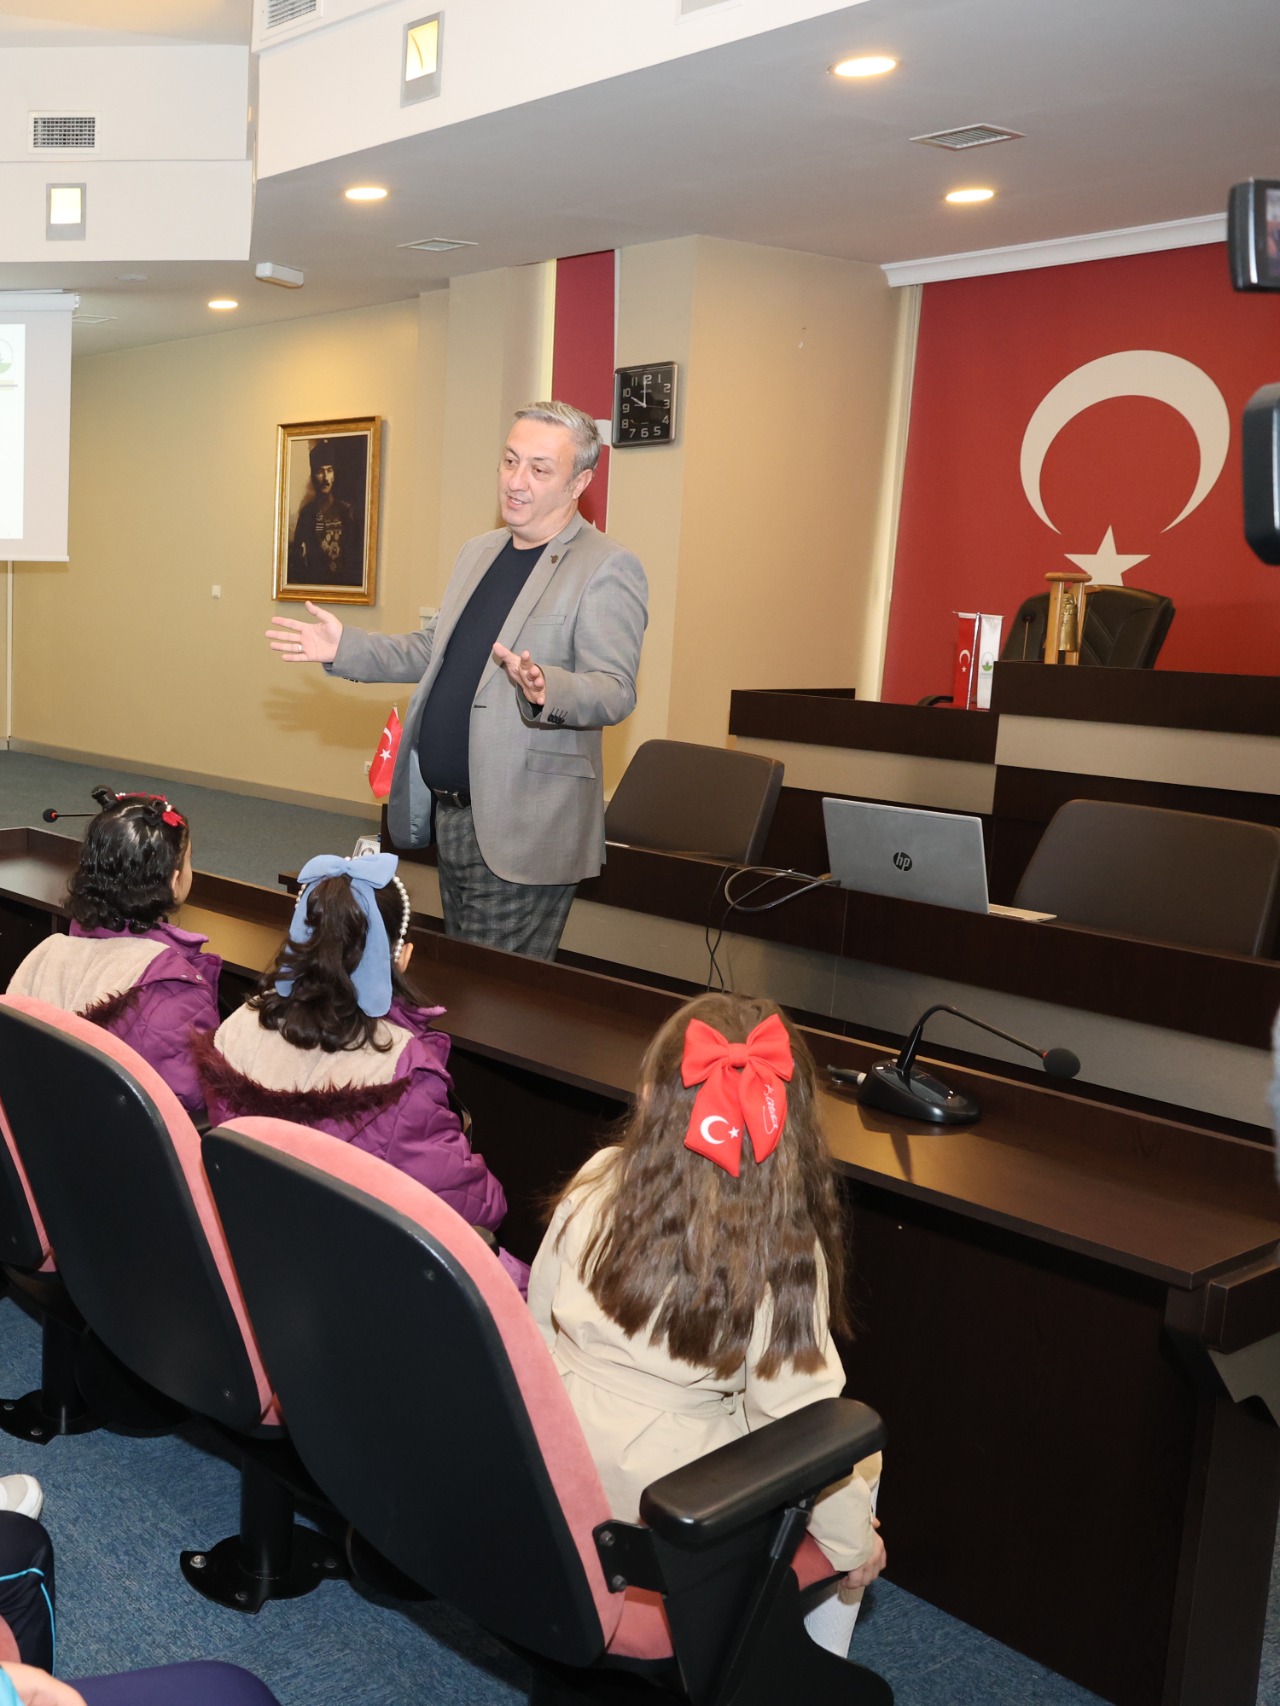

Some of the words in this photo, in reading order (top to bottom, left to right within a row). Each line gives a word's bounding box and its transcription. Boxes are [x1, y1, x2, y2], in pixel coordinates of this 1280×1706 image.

[631, 377, 638, 386] 11
[623, 388, 631, 397] 10
[664, 383, 670, 393] 2
[623, 404, 629, 413] 9
[663, 399, 670, 409] 3
[622, 419, 629, 428] 8
[662, 416, 669, 424] 4
[629, 429, 636, 438] 7
[641, 428, 649, 437] 6
[654, 426, 661, 435] 5
[895, 851, 910, 871] hp
